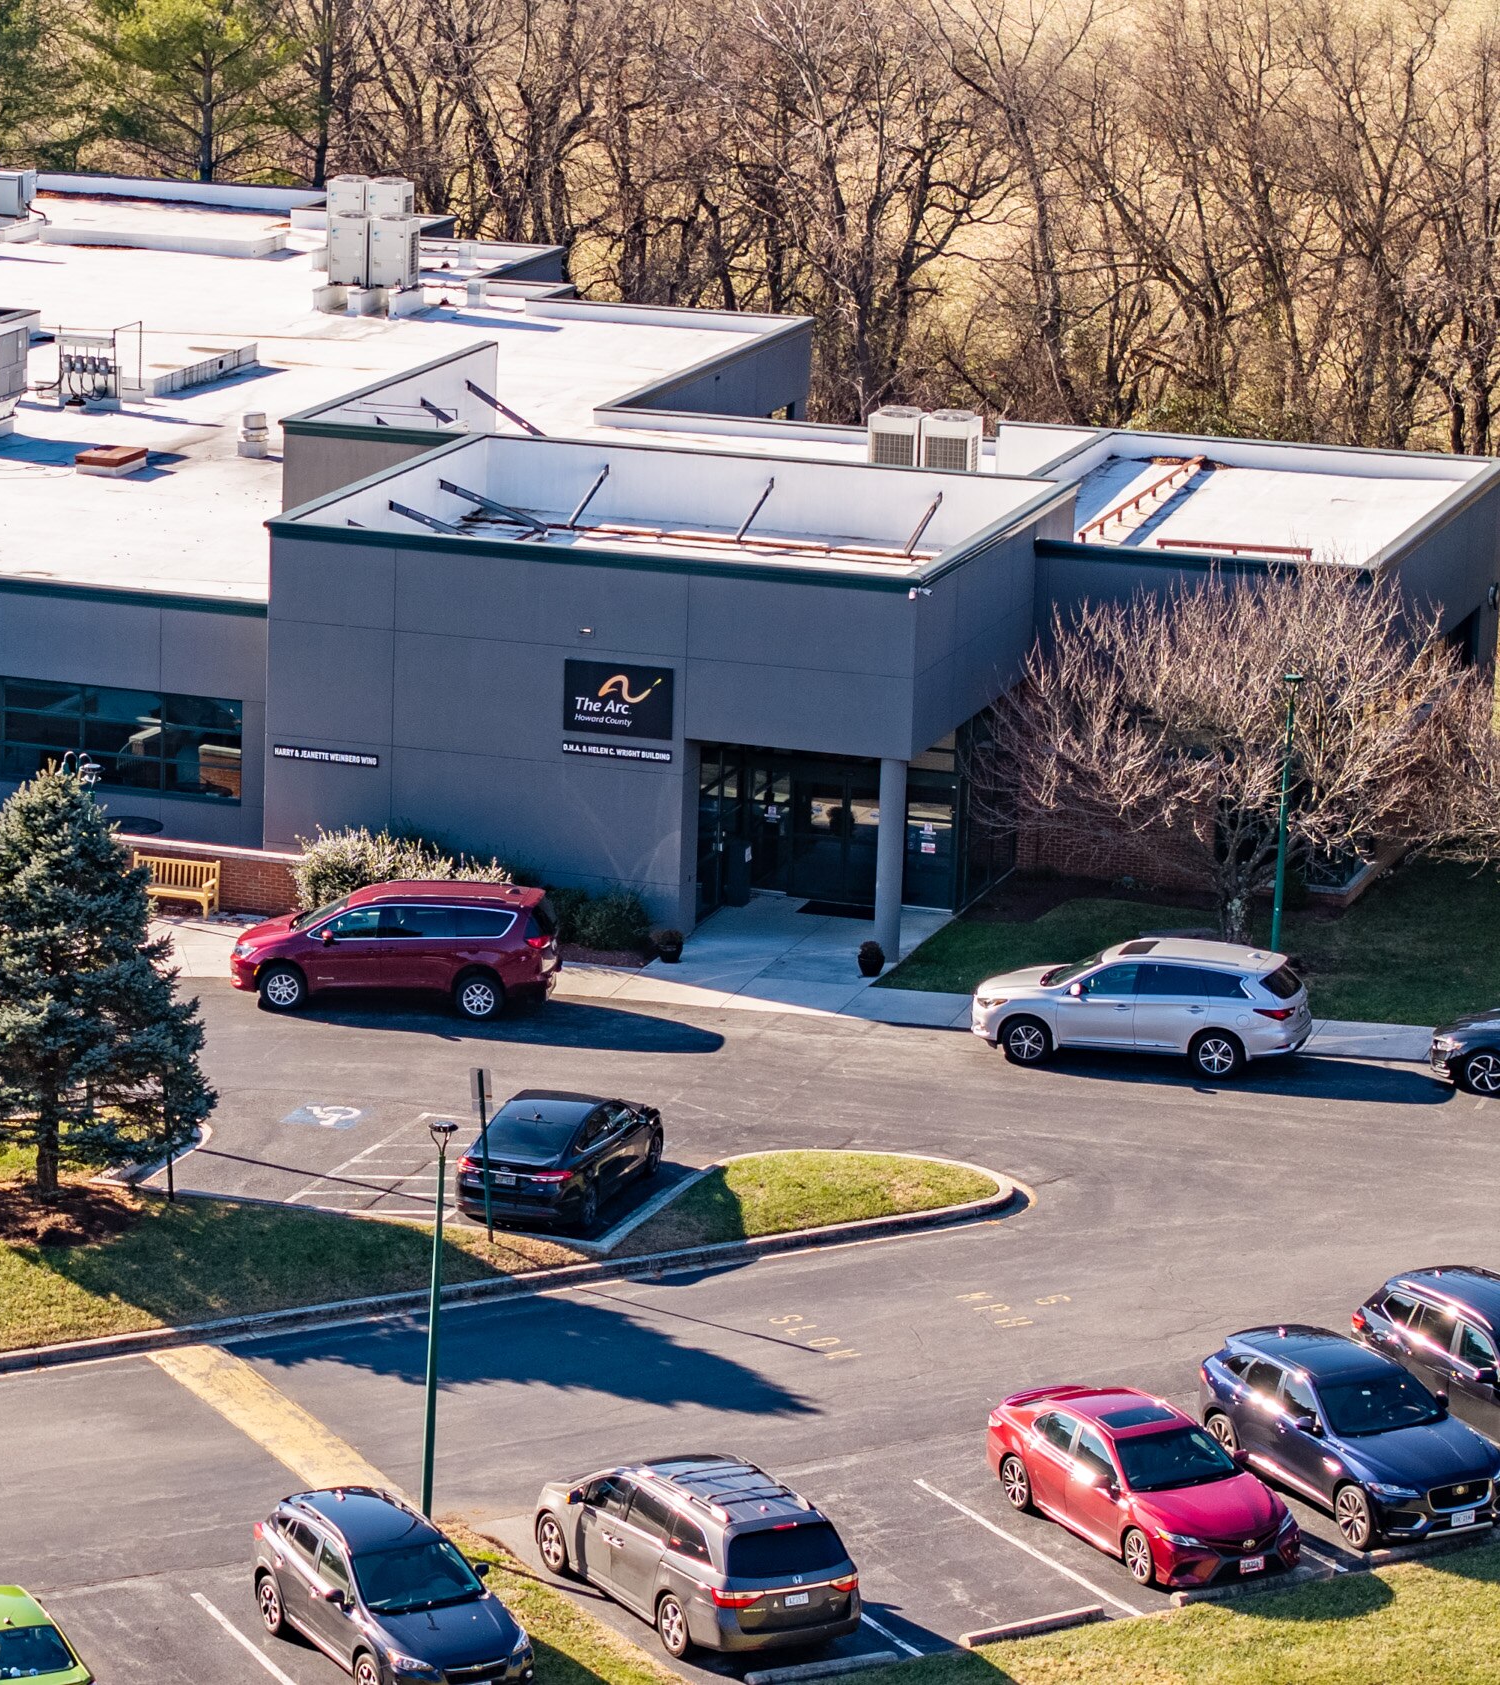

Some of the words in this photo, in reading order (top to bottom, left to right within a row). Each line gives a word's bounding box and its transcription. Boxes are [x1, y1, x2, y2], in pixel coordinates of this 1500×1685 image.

[575, 697, 602, 712] The
[604, 700, 631, 715] Arc
[574, 713, 604, 723] Howard
[605, 716, 633, 728] County
[274, 747, 294, 757] HARRY
[294, 749, 300, 758] &
[300, 750, 330, 760] JEANETTE
[330, 753, 361, 764] WEINBERG
[361, 756, 377, 766] WING
[582, 745, 588, 753] &
[588, 746, 609, 755] HELEN
[616, 748, 640, 758] WRIGHT
[641, 751, 671, 761] BUILDING
[956, 1292, 1034, 1329] MPH
[768, 1313, 862, 1360] SLOW
